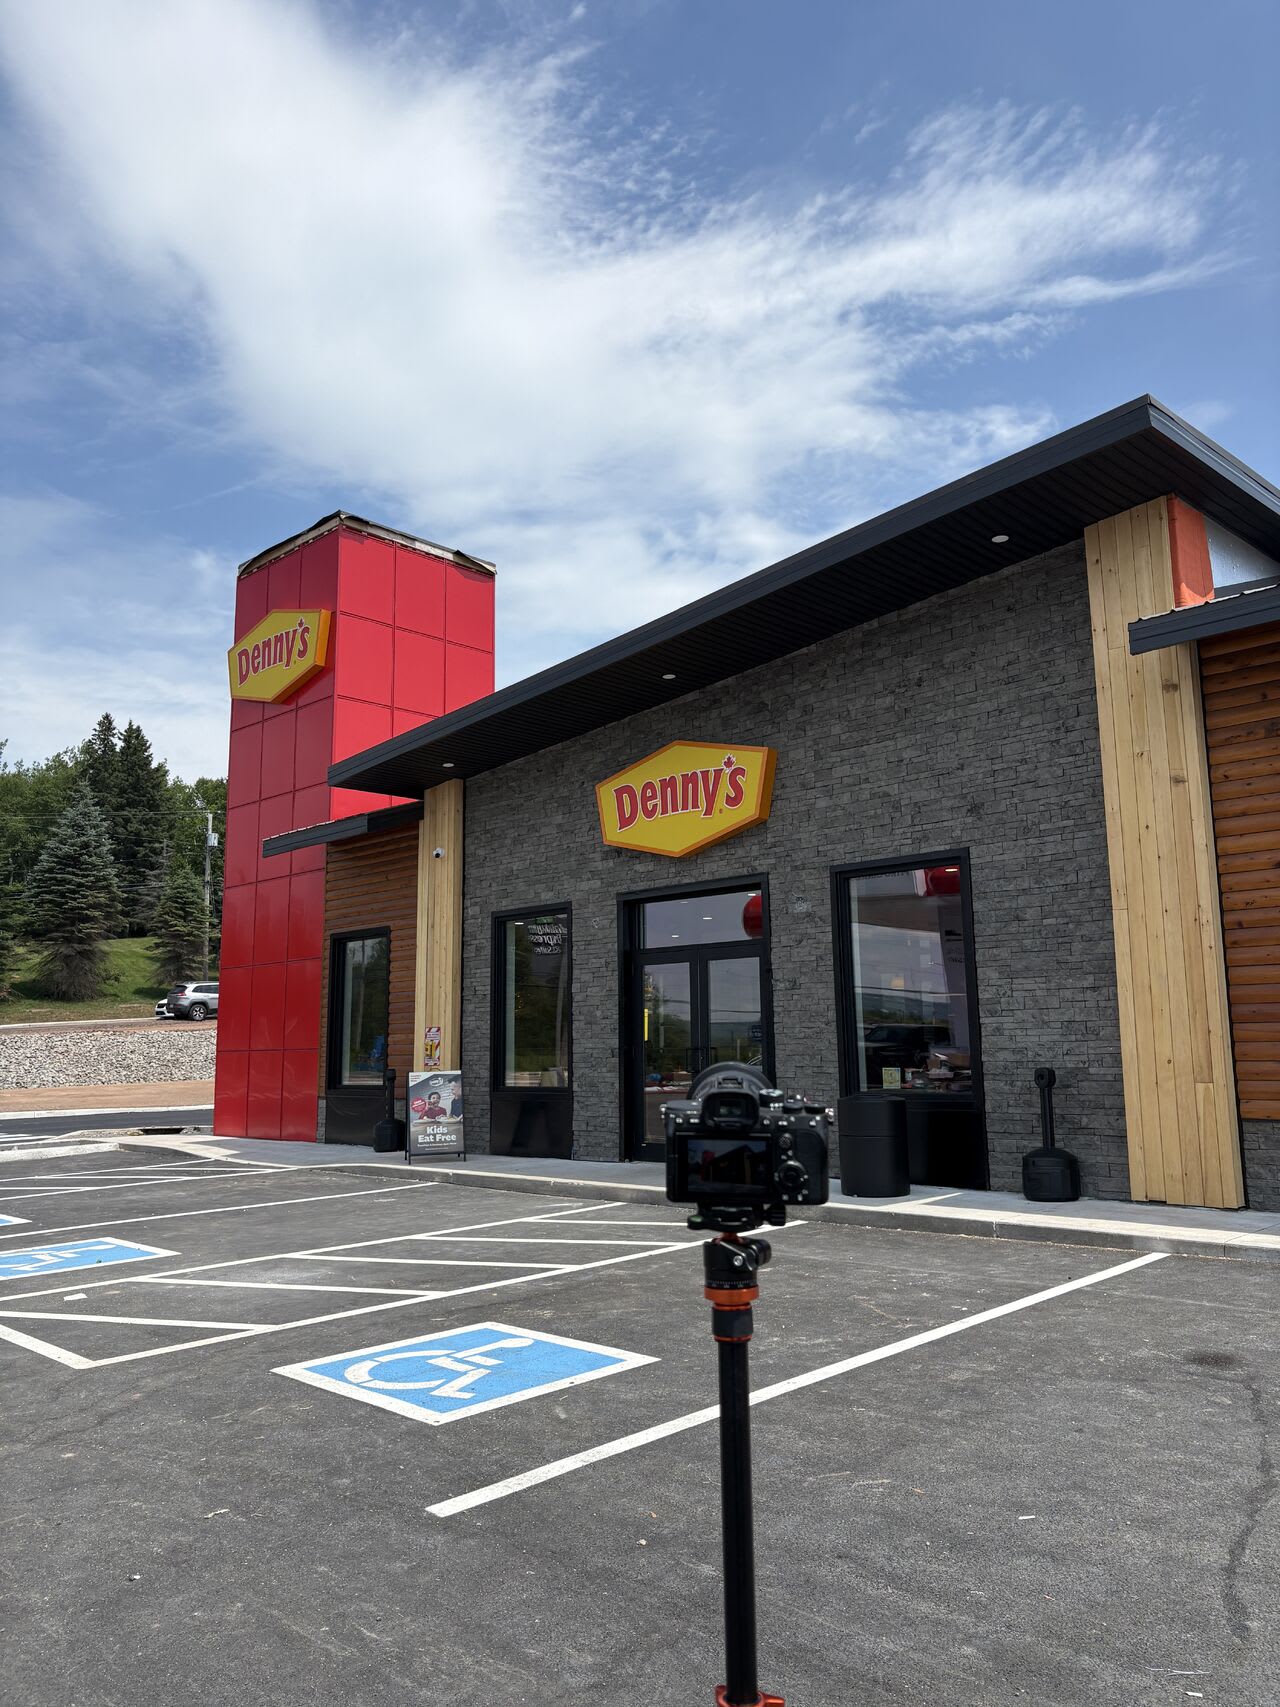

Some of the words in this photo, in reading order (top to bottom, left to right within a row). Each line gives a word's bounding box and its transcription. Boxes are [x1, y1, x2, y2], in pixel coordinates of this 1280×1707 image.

[236, 616, 311, 688] Denny's
[612, 754, 747, 832] Denny's
[418, 1135, 434, 1143] Eat
[436, 1134, 457, 1142] Free
[427, 1125, 448, 1134] Kids
